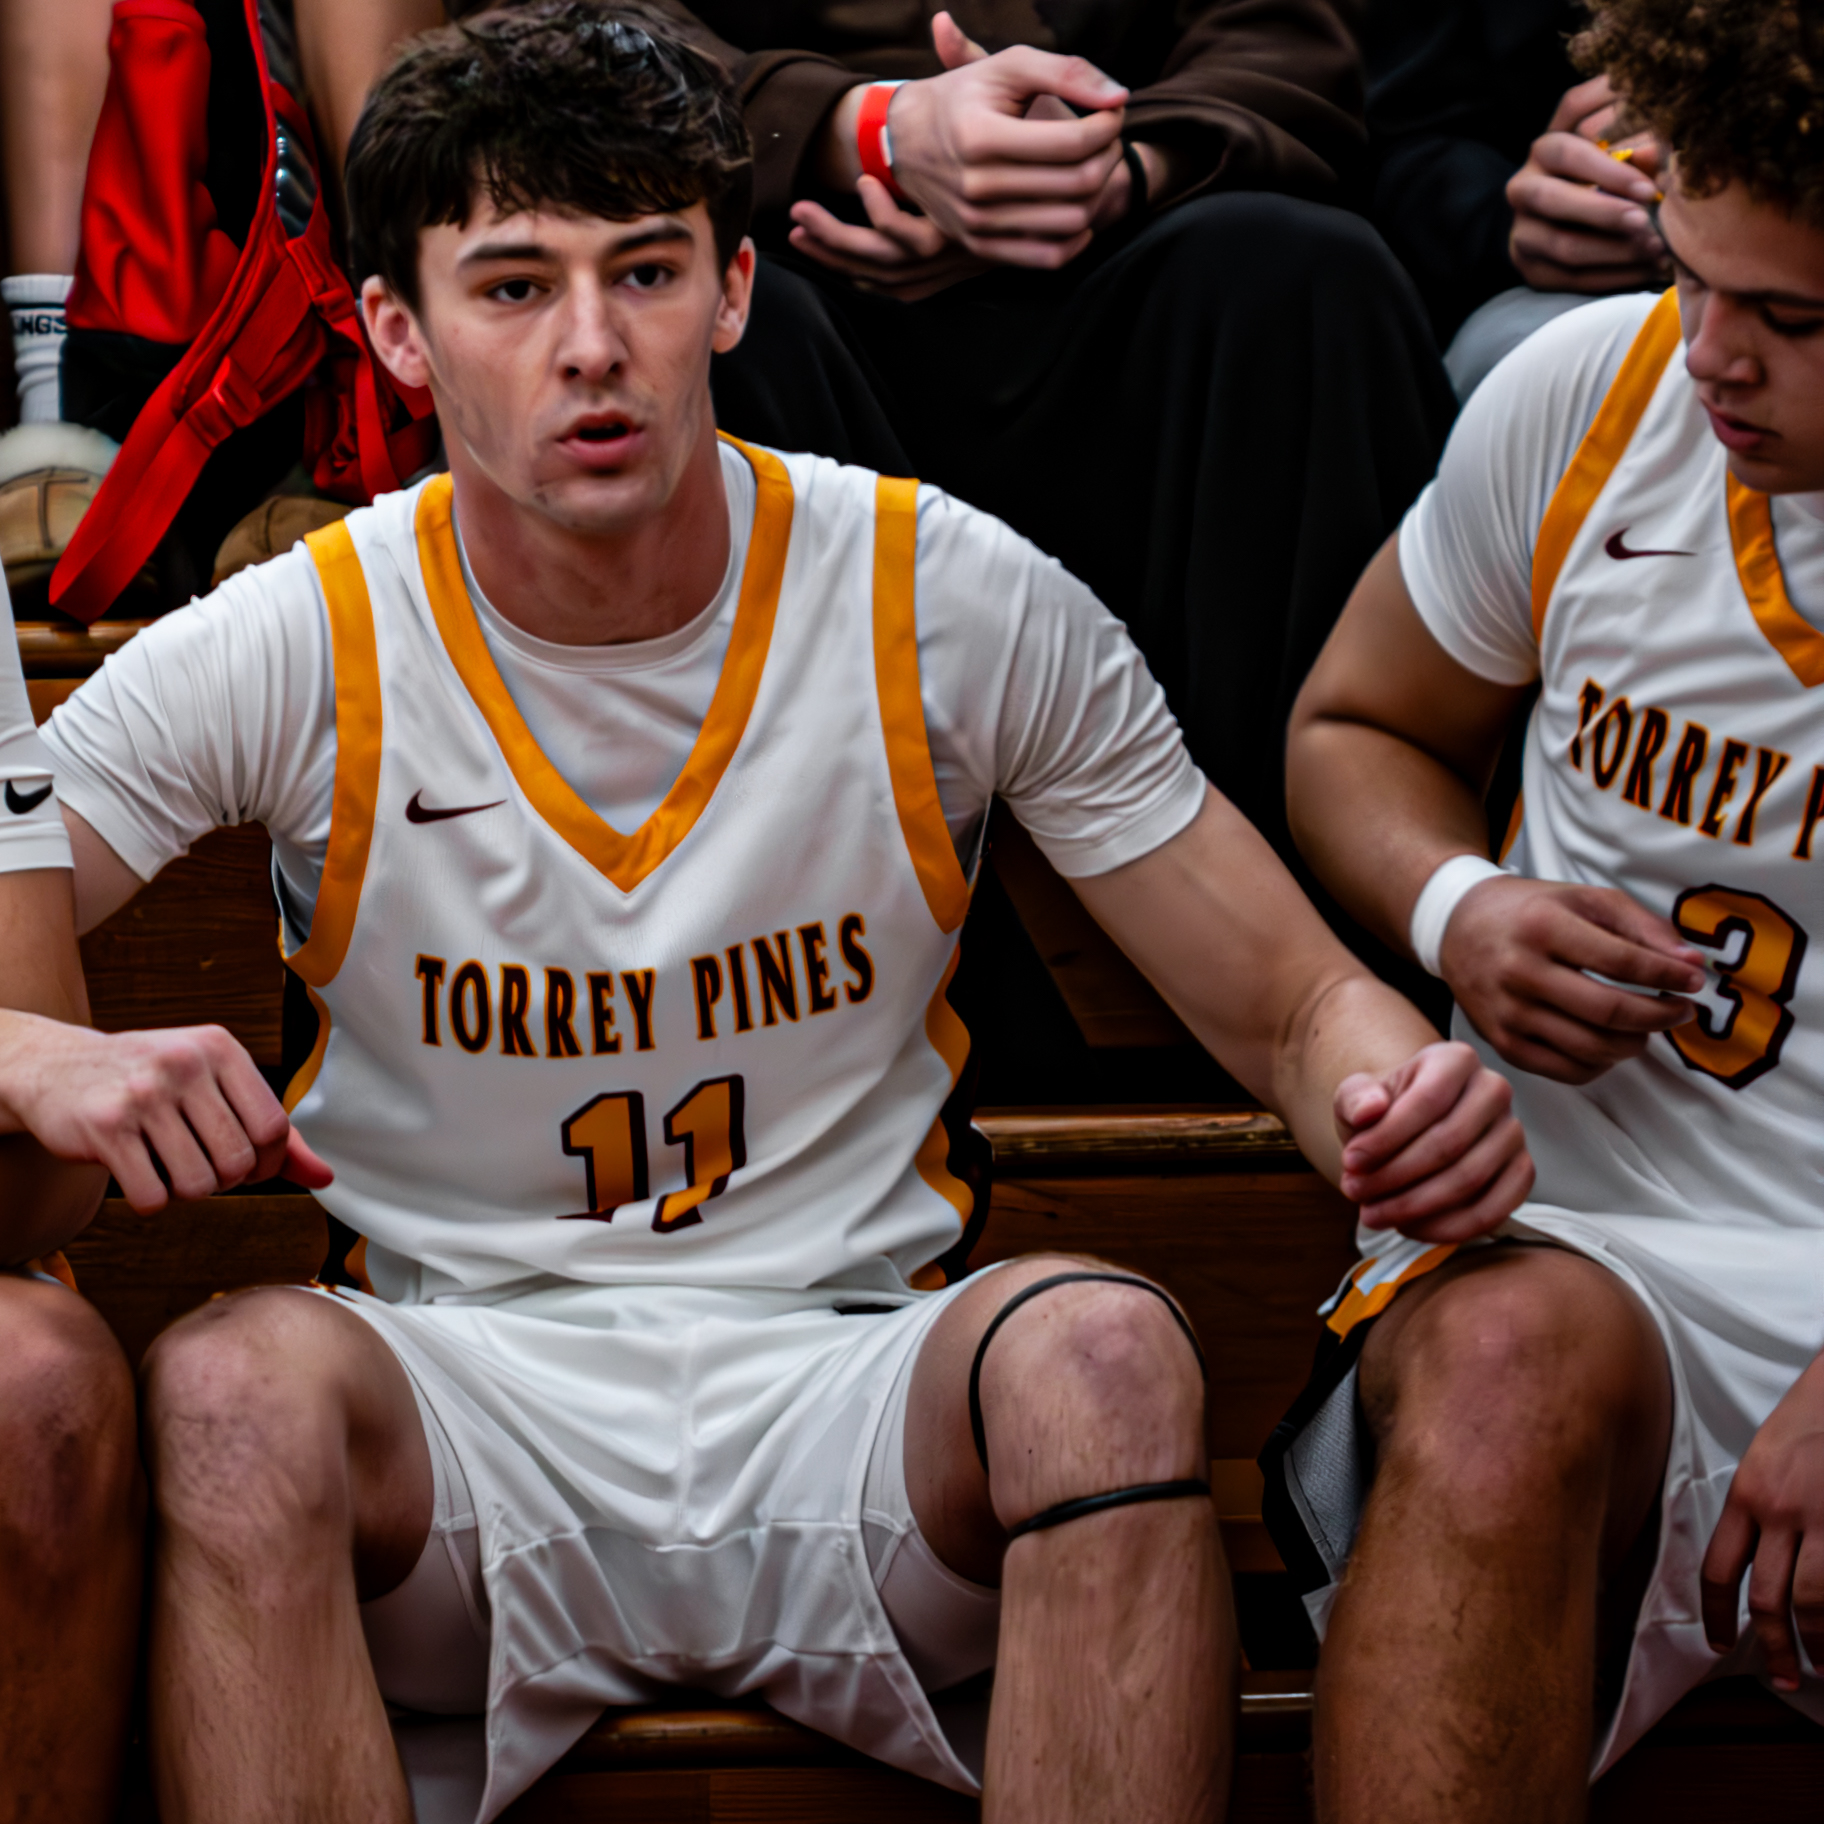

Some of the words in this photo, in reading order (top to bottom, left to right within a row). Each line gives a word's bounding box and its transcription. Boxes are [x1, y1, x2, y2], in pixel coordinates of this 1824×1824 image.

[1569, 676, 1791, 847] TORREY
[414, 952, 657, 1059] TORREY
[689, 911, 876, 1042] PINES
[555, 1072, 747, 1235] 11
